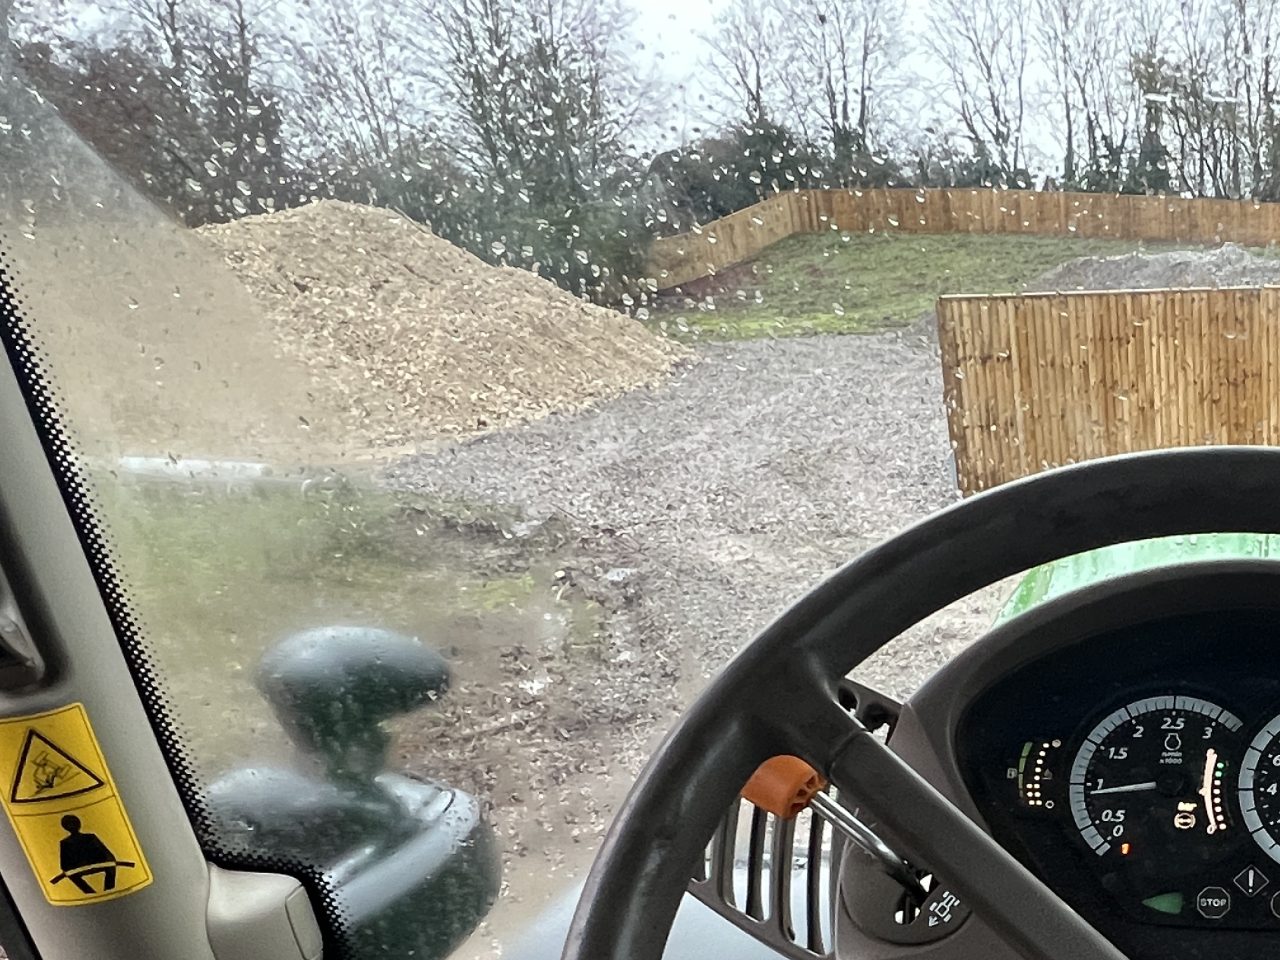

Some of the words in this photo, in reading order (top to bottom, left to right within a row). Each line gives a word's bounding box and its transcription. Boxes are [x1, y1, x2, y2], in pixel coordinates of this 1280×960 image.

[1161, 717, 1186, 729] 2.5
[1132, 726, 1144, 738] 2
[1202, 727, 1213, 739] 3
[1108, 747, 1128, 759] 1.5
[1096, 778, 1104, 790] 1
[1266, 783, 1278, 795] 4
[1101, 809, 1126, 822] 0.5
[1112, 824, 1124, 836] 0
[1200, 898, 1227, 907] STOP
